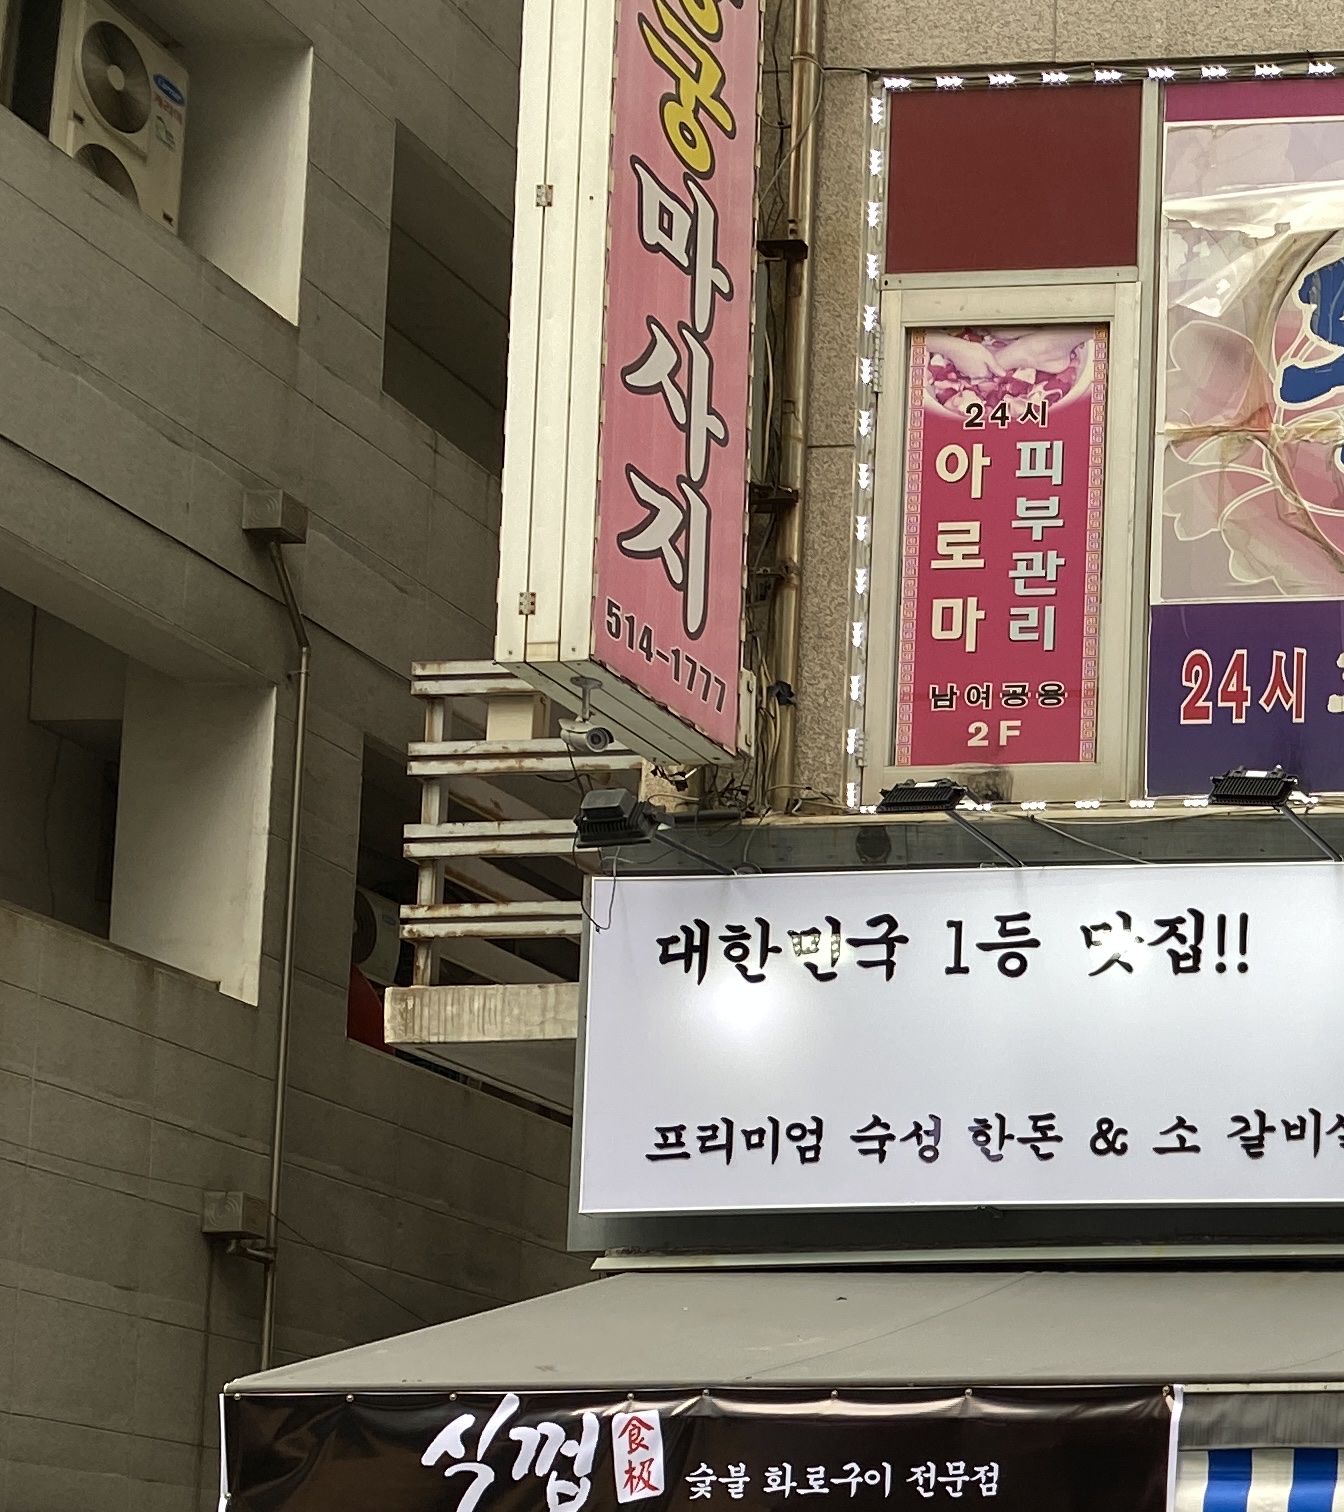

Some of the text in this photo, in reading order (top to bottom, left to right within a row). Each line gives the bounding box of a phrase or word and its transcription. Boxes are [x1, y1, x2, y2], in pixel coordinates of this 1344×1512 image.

[617, 155, 734, 640] 마사지
[964, 403, 1048, 428] 24시
[931, 443, 990, 652] 아로마
[605, 597, 726, 713] 514-1777
[1180, 647, 1308, 725] 24시
[930, 682, 1067, 709] 남여공용
[967, 721, 1021, 747] 2F
[656, 908, 1250, 984] 대한민국 1등 맛집!!
[644, 1116, 826, 1166] 프리미엄
[849, 1114, 942, 1164] 숙성
[968, 1112, 1065, 1163] 한돈
[1089, 1117, 1129, 1155] &
[1152, 1117, 1202, 1155] 소
[684, 1460, 1001, 1500] 숯불 화로구이 전문점
